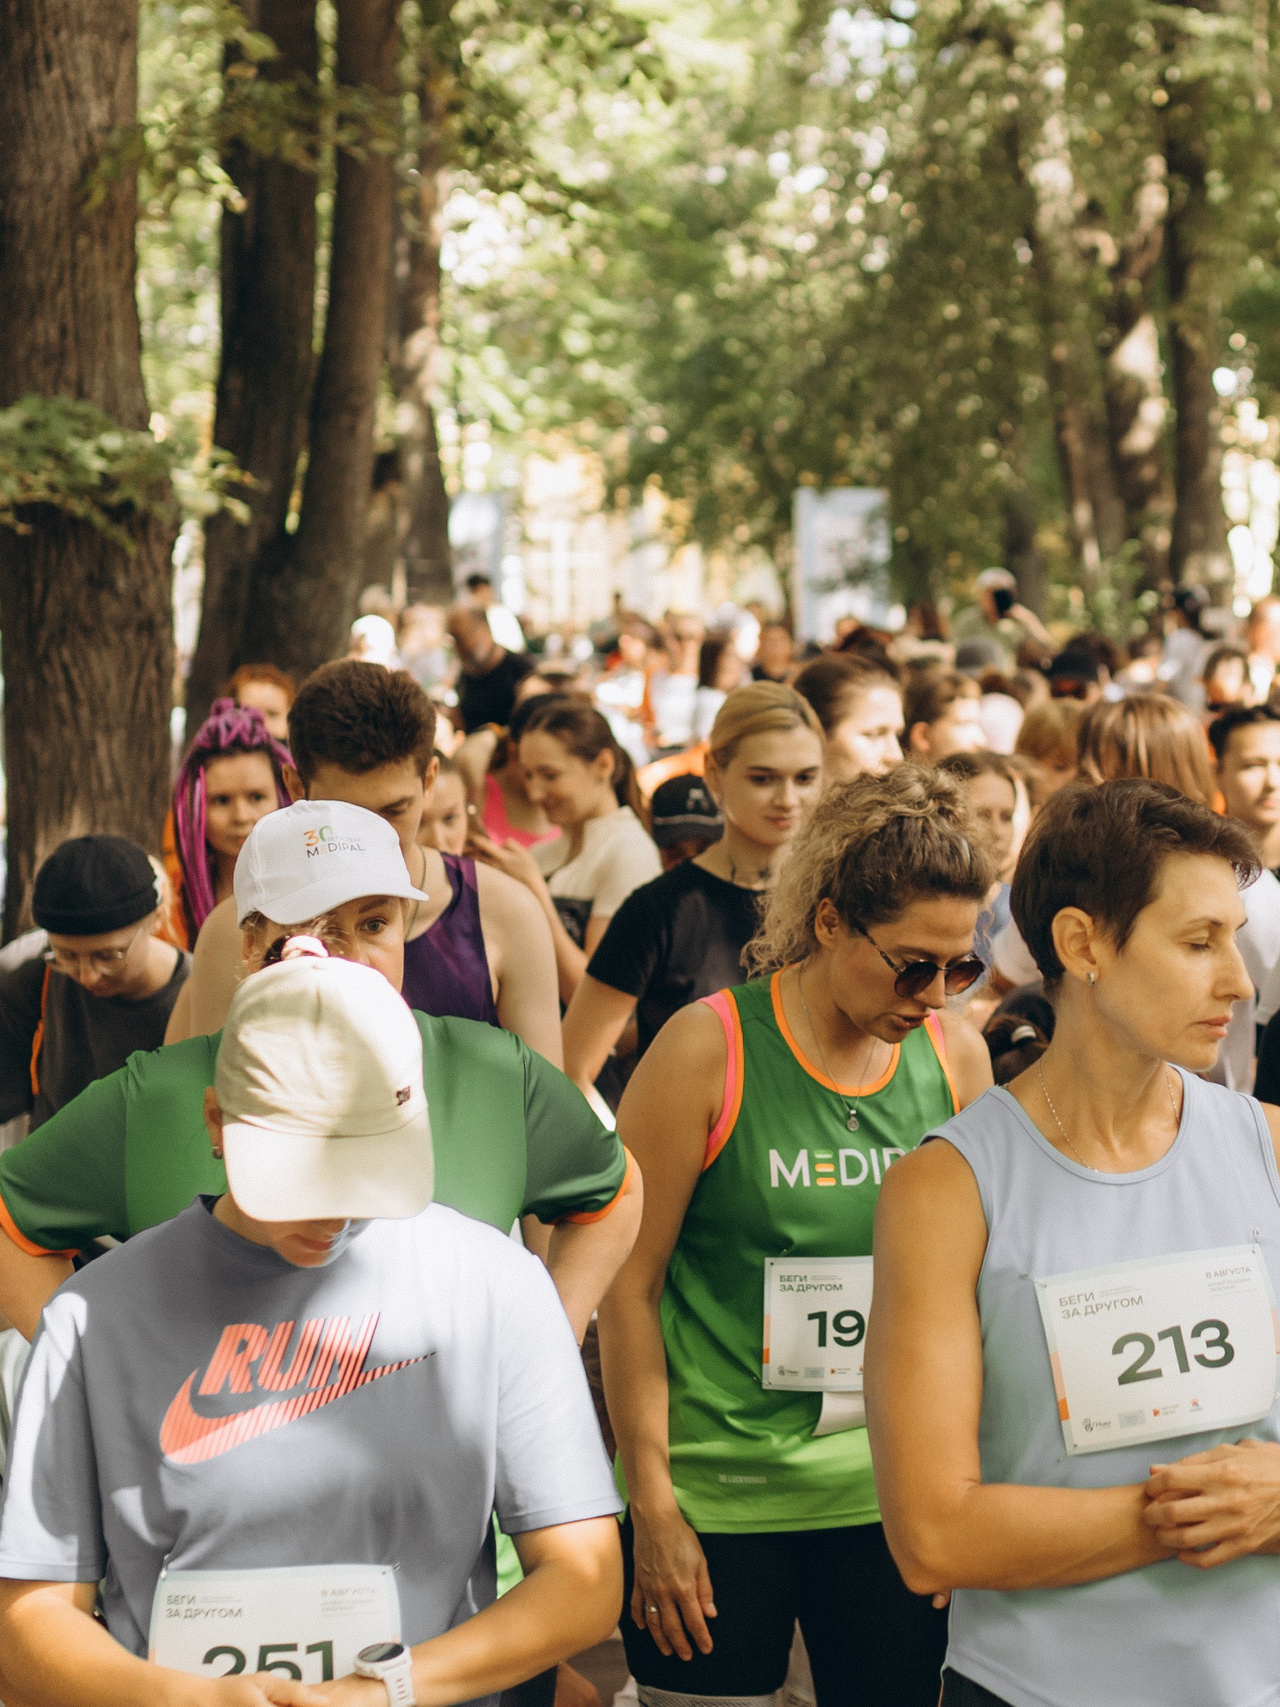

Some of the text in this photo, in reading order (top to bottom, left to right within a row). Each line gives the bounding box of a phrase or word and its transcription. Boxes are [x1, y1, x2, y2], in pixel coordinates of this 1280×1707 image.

[306, 842, 366, 858] MEDIPAL
[779, 1274, 808, 1283] БЕГИ
[779, 1284, 843, 1293] ЗА ДРУГОМ
[1059, 1291, 1095, 1307] БЕГИ
[1062, 1295, 1144, 1319] ЗА ДРУГОМ
[198, 1312, 381, 1396] RUN
[1112, 1319, 1235, 1386] 213
[166, 1595, 197, 1605] БЕГИ
[165, 1608, 243, 1619] ЗА ДРУГОМ
